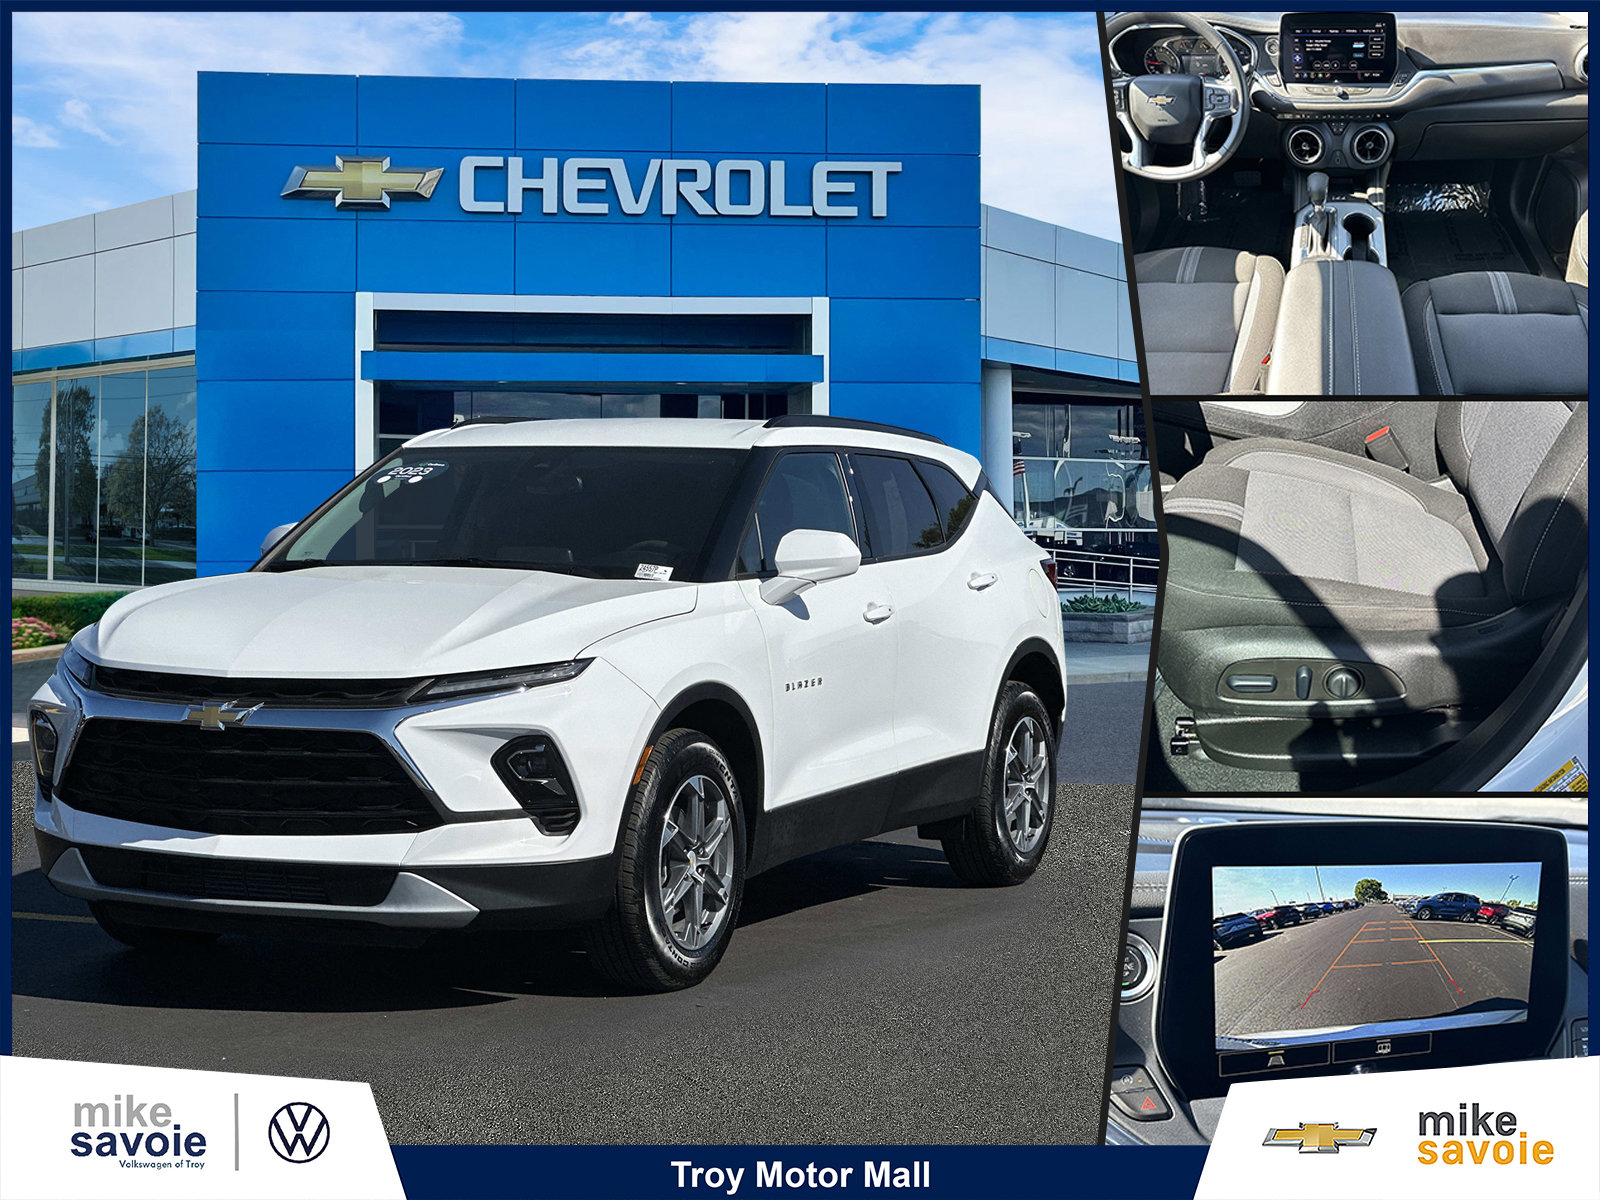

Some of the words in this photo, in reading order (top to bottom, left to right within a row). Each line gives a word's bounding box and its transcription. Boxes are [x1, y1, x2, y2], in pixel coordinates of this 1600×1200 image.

[459, 155, 902, 217] CHEVROLET
[388, 466, 434, 476] 2023
[785, 677, 823, 692] BLAZER
